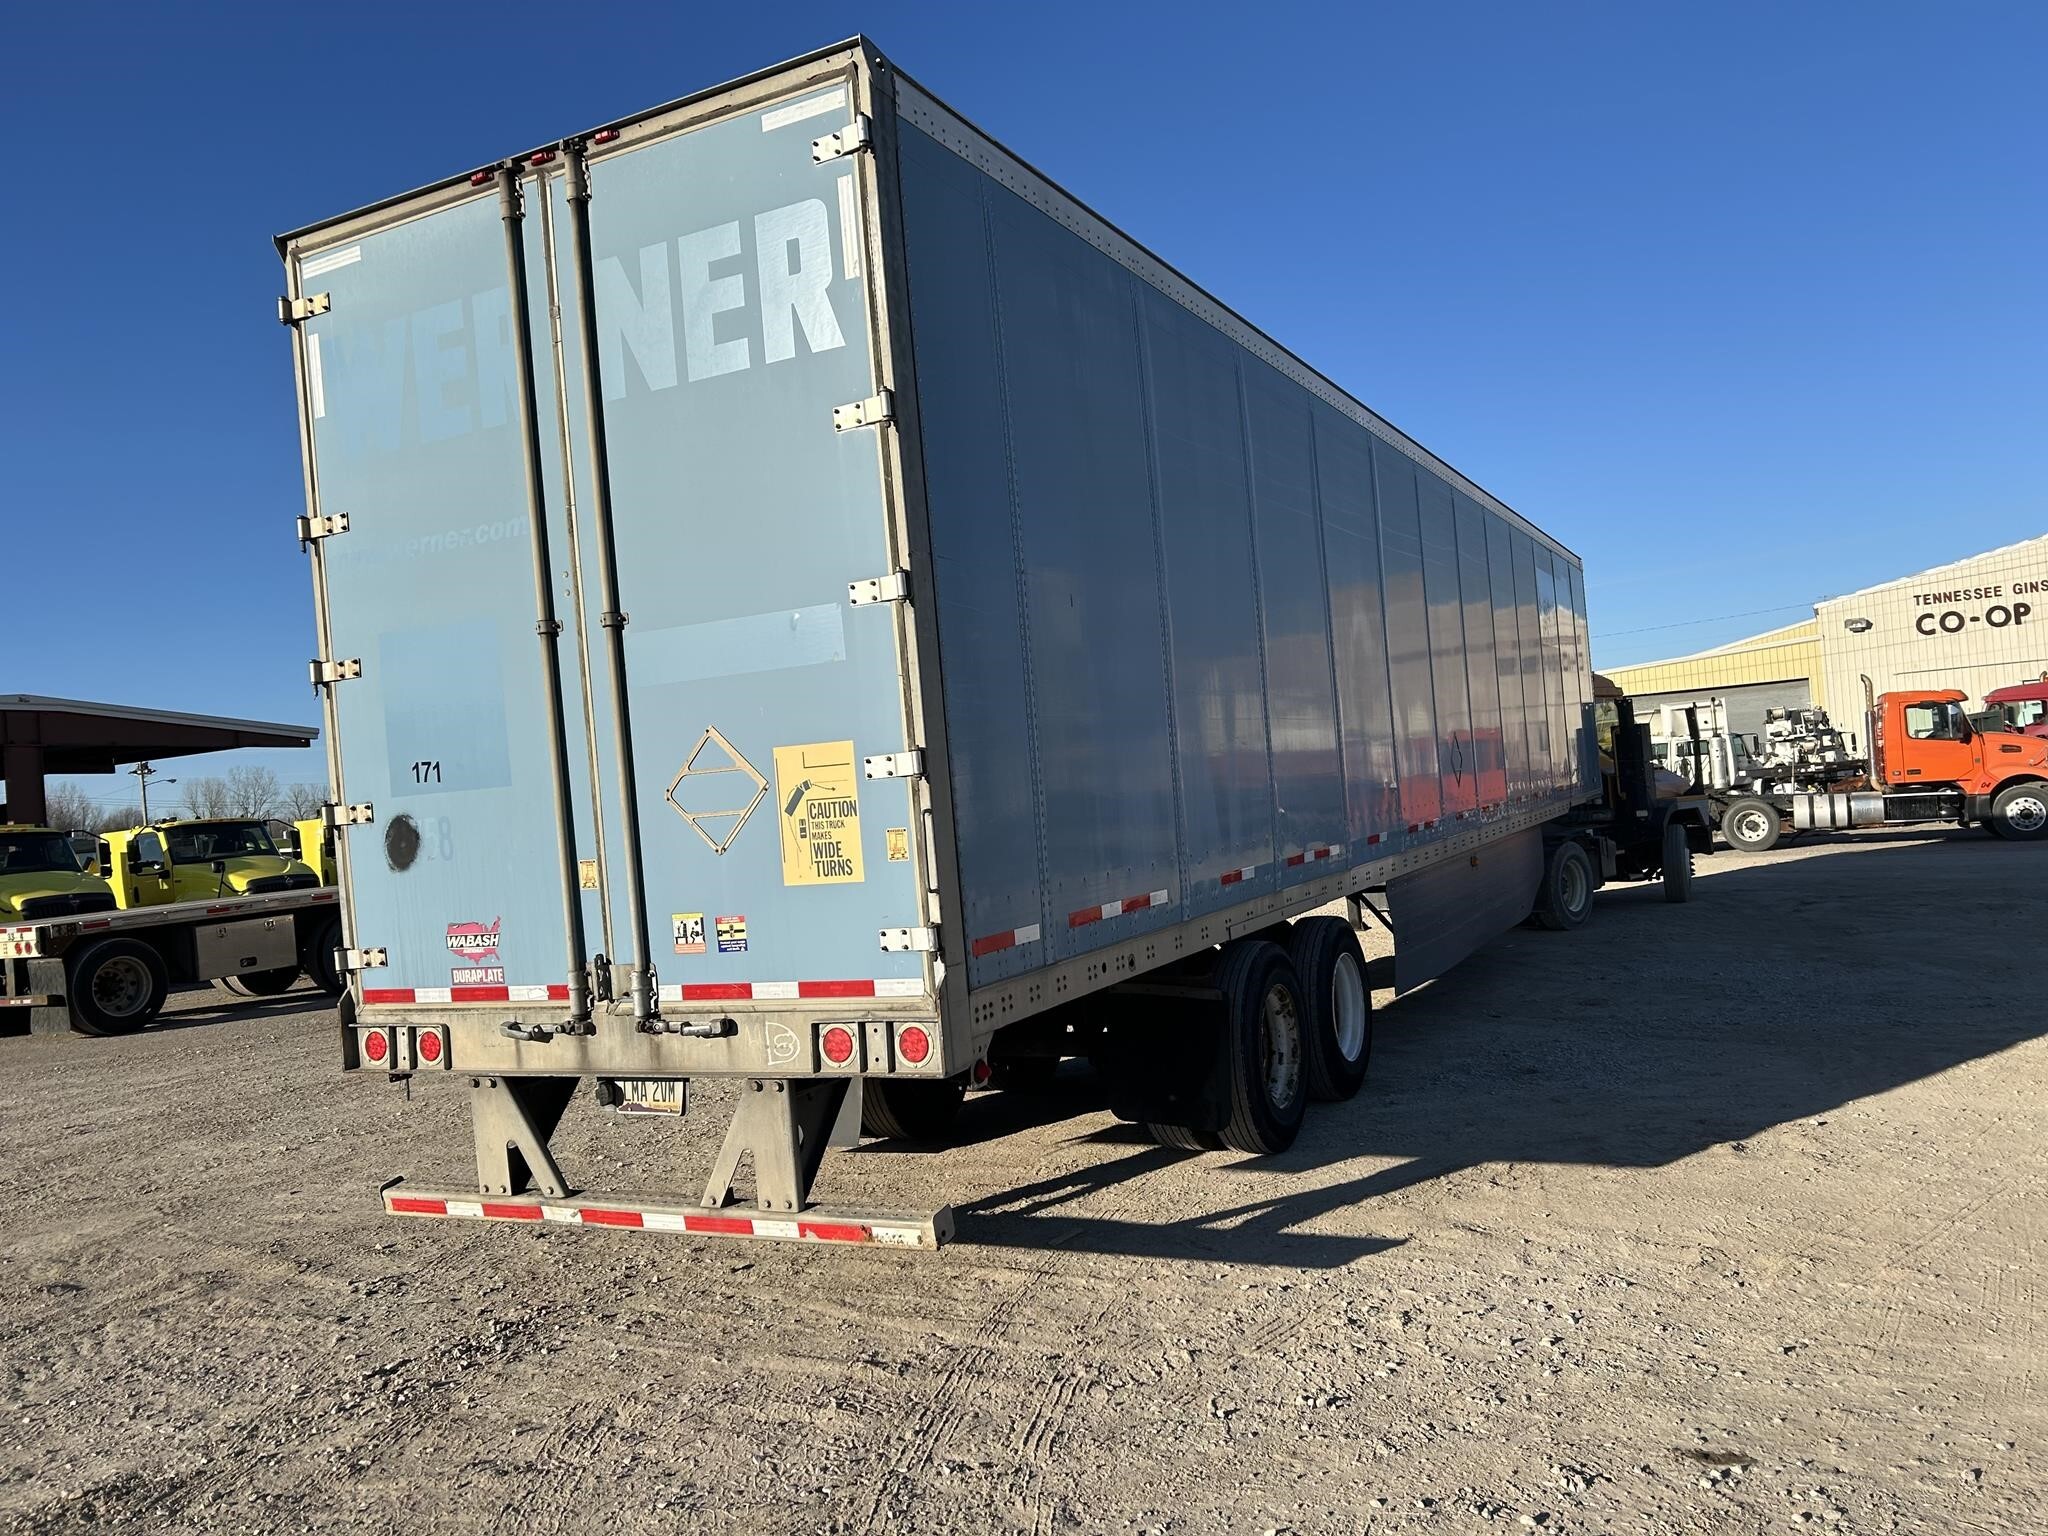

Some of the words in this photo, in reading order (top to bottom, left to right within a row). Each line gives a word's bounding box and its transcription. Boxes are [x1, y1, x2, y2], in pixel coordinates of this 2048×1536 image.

[1913, 586, 2002, 606] TENNESSEE
[2012, 579, 2048, 595] GINS
[1915, 602, 2031, 636] CO-OP
[411, 761, 441, 783] 171
[809, 799, 858, 820] CAUTION
[811, 820, 825, 830] THIS
[825, 819, 846, 829] TRUCK
[811, 830, 833, 840] MAKES
[813, 840, 843, 859] WIDE
[814, 858, 853, 878] TURNS
[446, 934, 500, 948] WABASH
[452, 968, 504, 983] DURAPLATE
[623, 1081, 648, 1102] LMA
